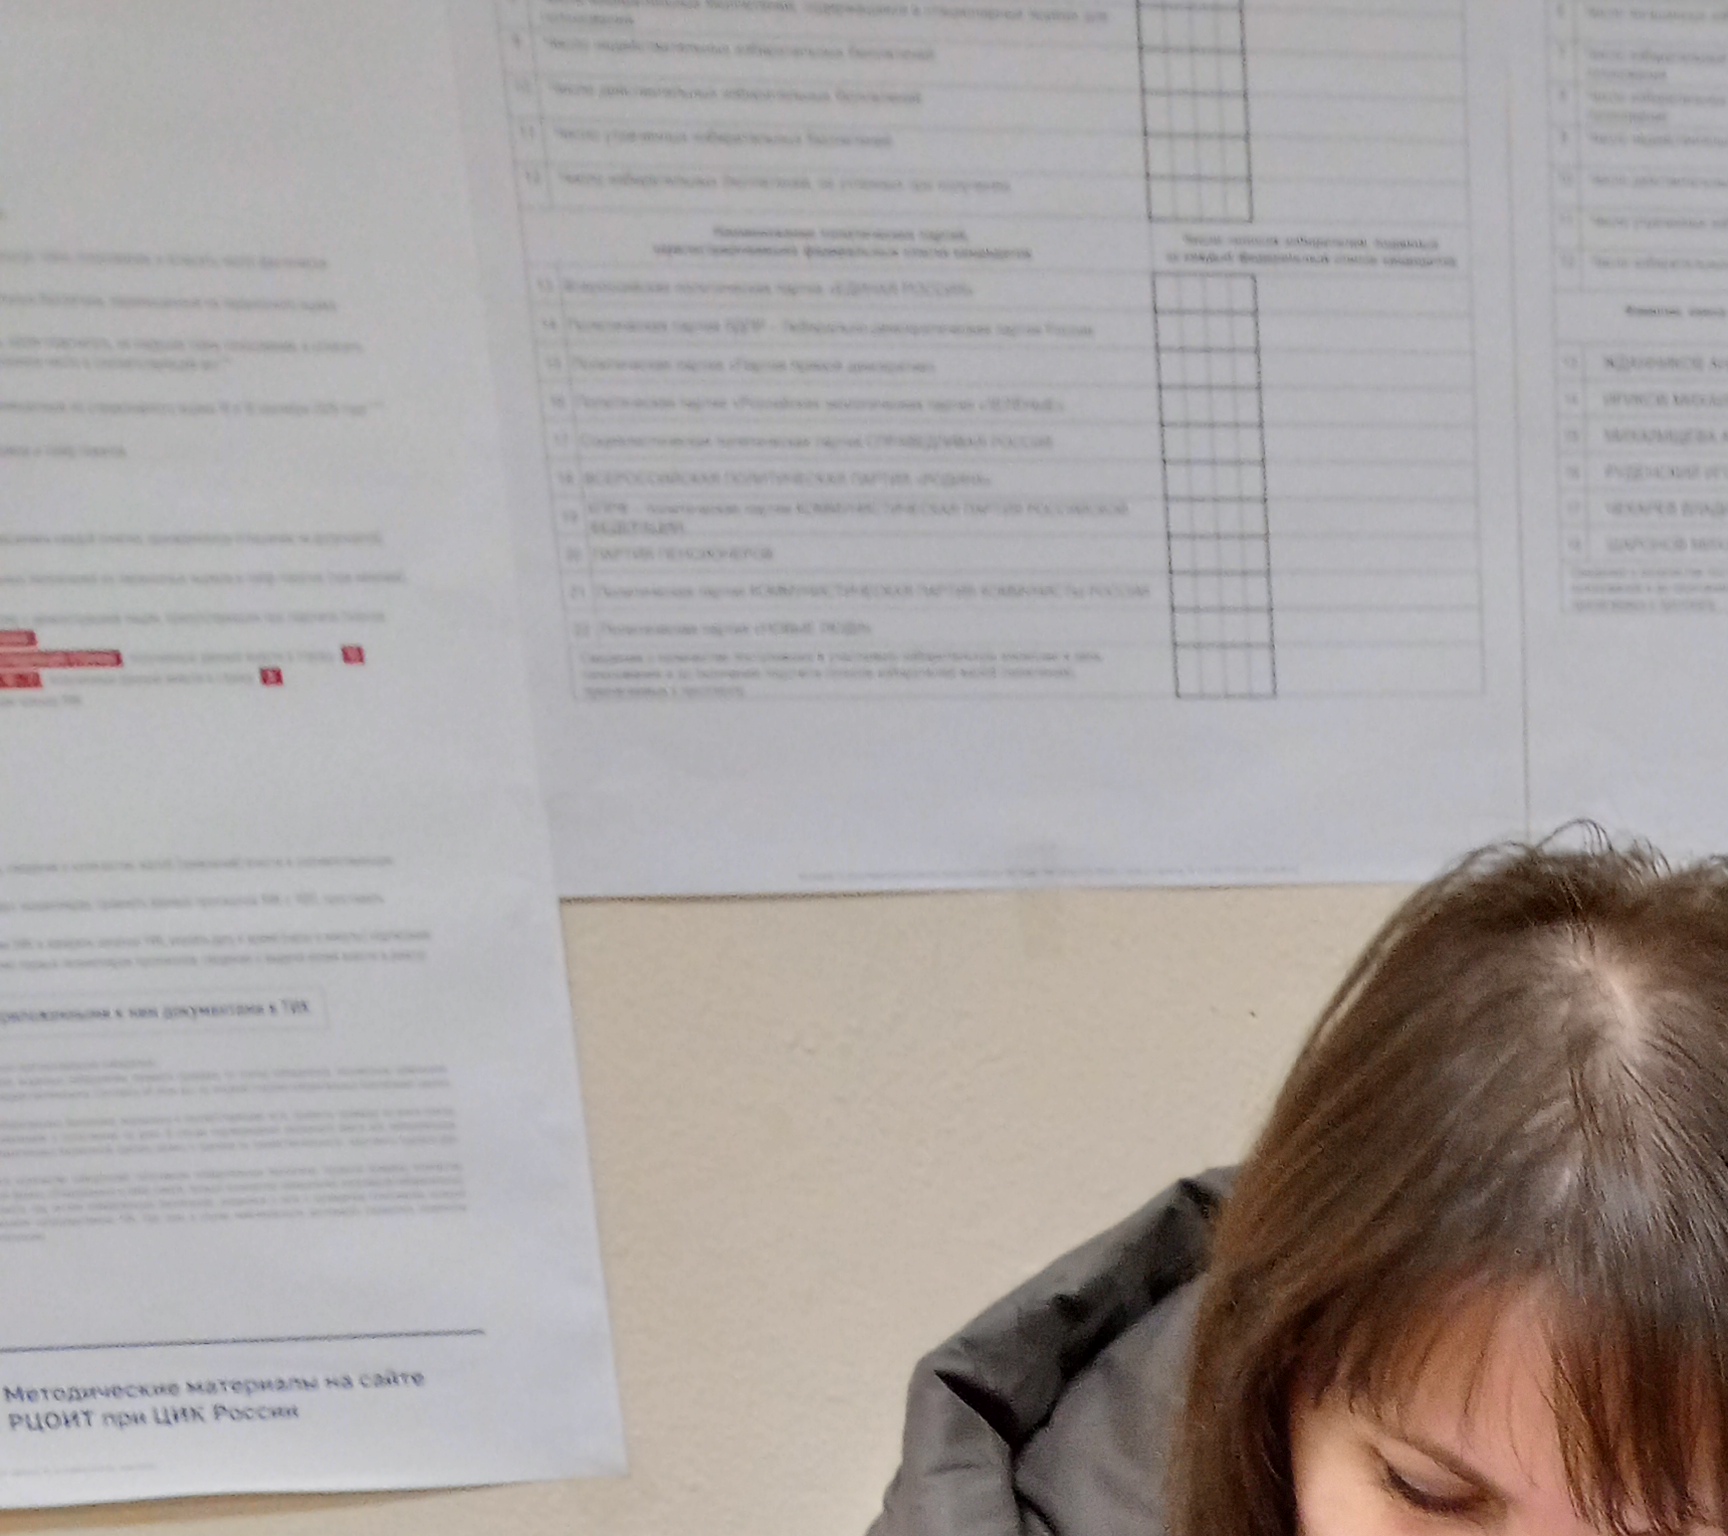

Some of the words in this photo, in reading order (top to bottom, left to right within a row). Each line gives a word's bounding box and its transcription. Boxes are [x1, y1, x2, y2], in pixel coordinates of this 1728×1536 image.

[3, 1382, 180, 1403] Методические
[186, 1374, 319, 1398] материалы
[325, 1376, 353, 1391] на
[358, 1368, 426, 1389] сайте
[8, 1409, 95, 1433] РЦОИТ
[102, 1410, 146, 1428] при
[152, 1405, 206, 1427] ЦИК
[212, 1402, 300, 1421] России
